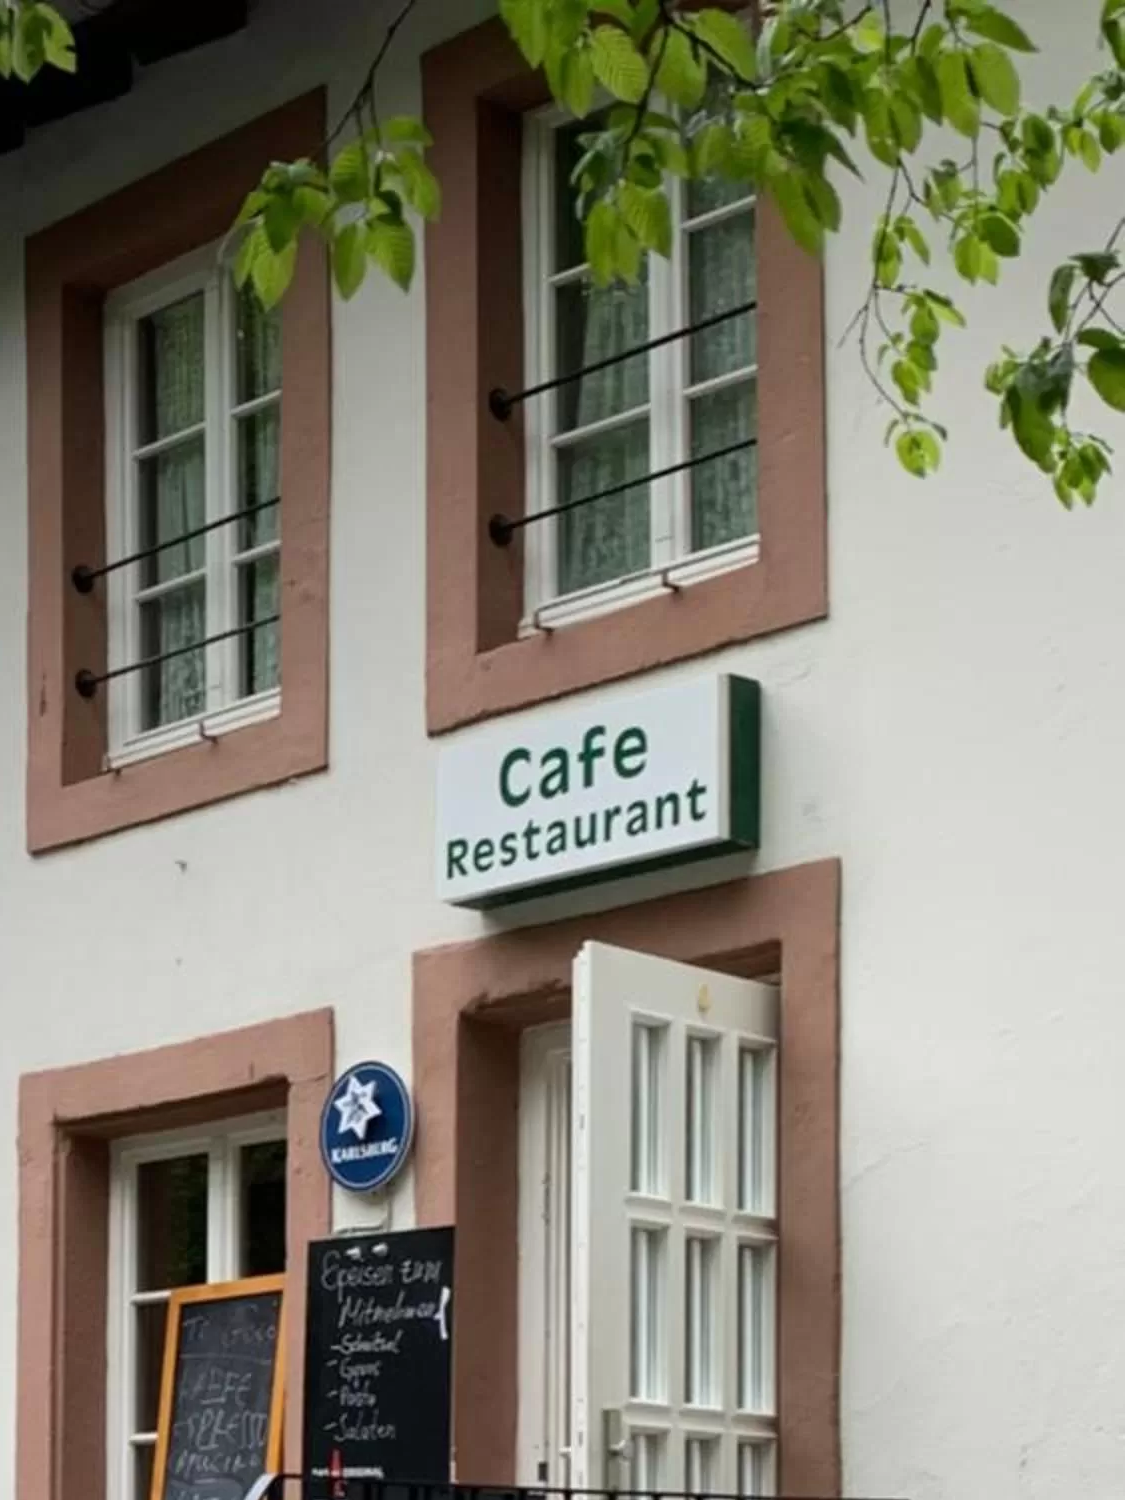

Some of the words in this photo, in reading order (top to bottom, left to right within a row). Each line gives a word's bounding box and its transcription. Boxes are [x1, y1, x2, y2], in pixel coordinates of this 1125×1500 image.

[499, 725, 648, 808] Cafe
[446, 779, 707, 879] Restaurant
[331, 1138, 398, 1164] KARLSBERG
